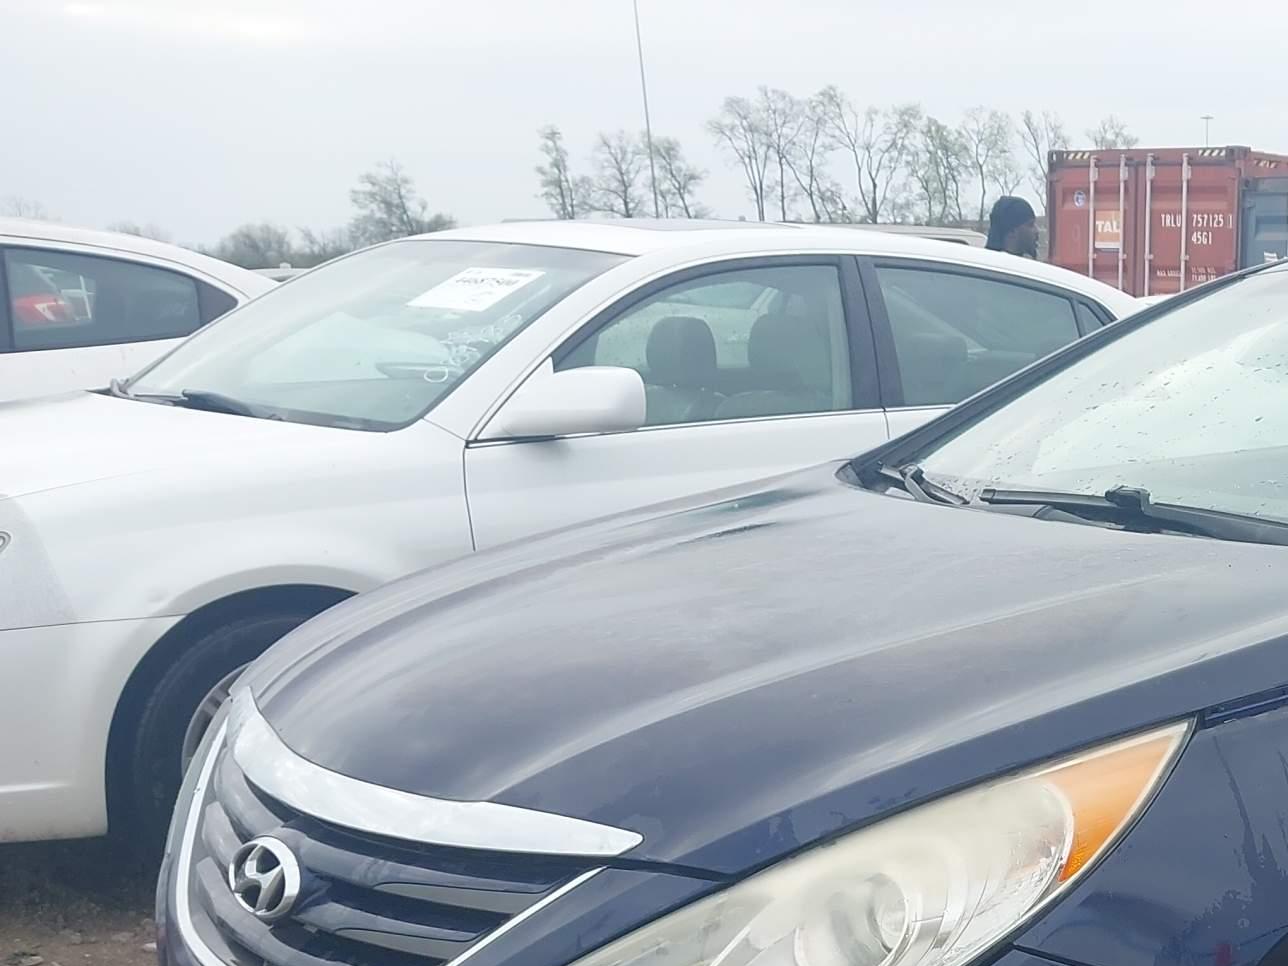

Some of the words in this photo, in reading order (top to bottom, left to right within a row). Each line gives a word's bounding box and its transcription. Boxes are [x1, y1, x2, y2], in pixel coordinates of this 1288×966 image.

[1095, 220, 1120, 233] TAL
[1161, 213, 1182, 228] TRLU
[1192, 213, 1224, 228] 757125
